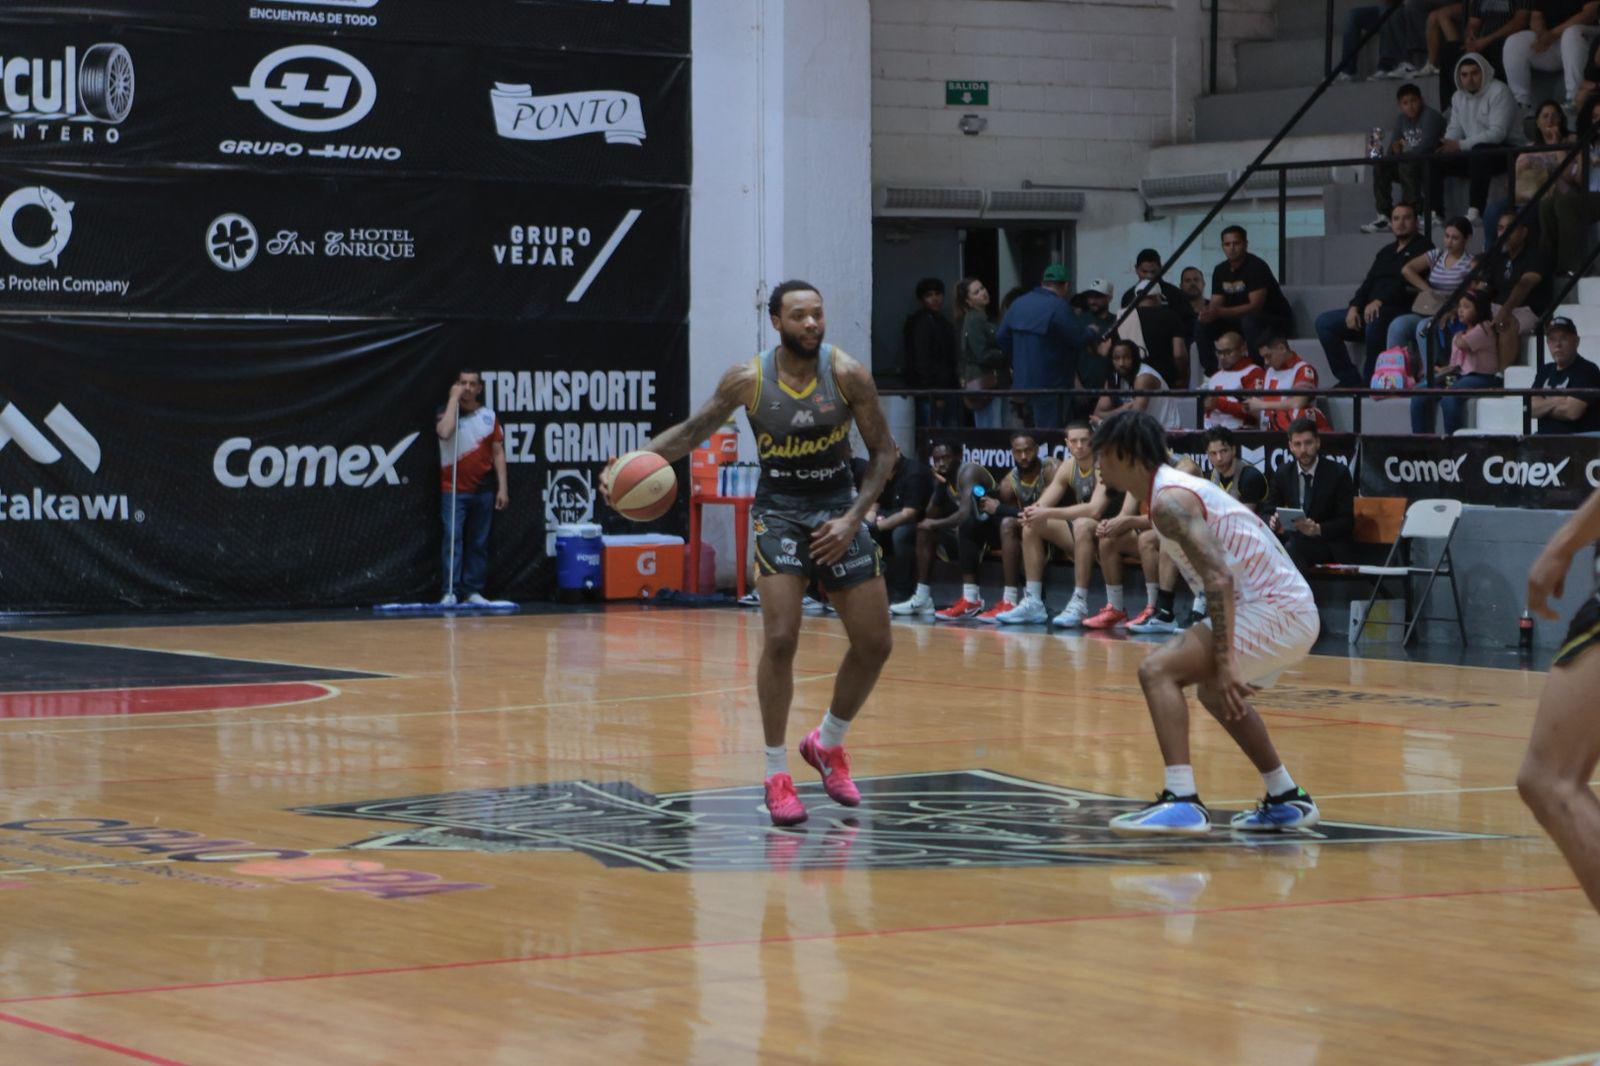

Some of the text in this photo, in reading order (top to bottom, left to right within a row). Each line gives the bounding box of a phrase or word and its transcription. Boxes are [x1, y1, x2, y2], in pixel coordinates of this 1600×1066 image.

[249, 8, 377, 26] ENCUENTRAS DE TODO
[949, 82, 986, 91] SALIDA
[512, 98, 628, 132] PONTO
[13, 123, 120, 143] NTERO
[219, 140, 303, 156] GRUPO
[350, 228, 414, 242] HOTEL
[510, 225, 591, 246] GRUPO
[493, 245, 574, 266] VEJAR
[9, 275, 60, 291] Protein
[62, 276, 130, 296] Company
[481, 370, 656, 412] TRANSPORTE
[213, 432, 420, 488] Comex
[962, 444, 1016, 468] hevron
[1384, 453, 1468, 483] Comex
